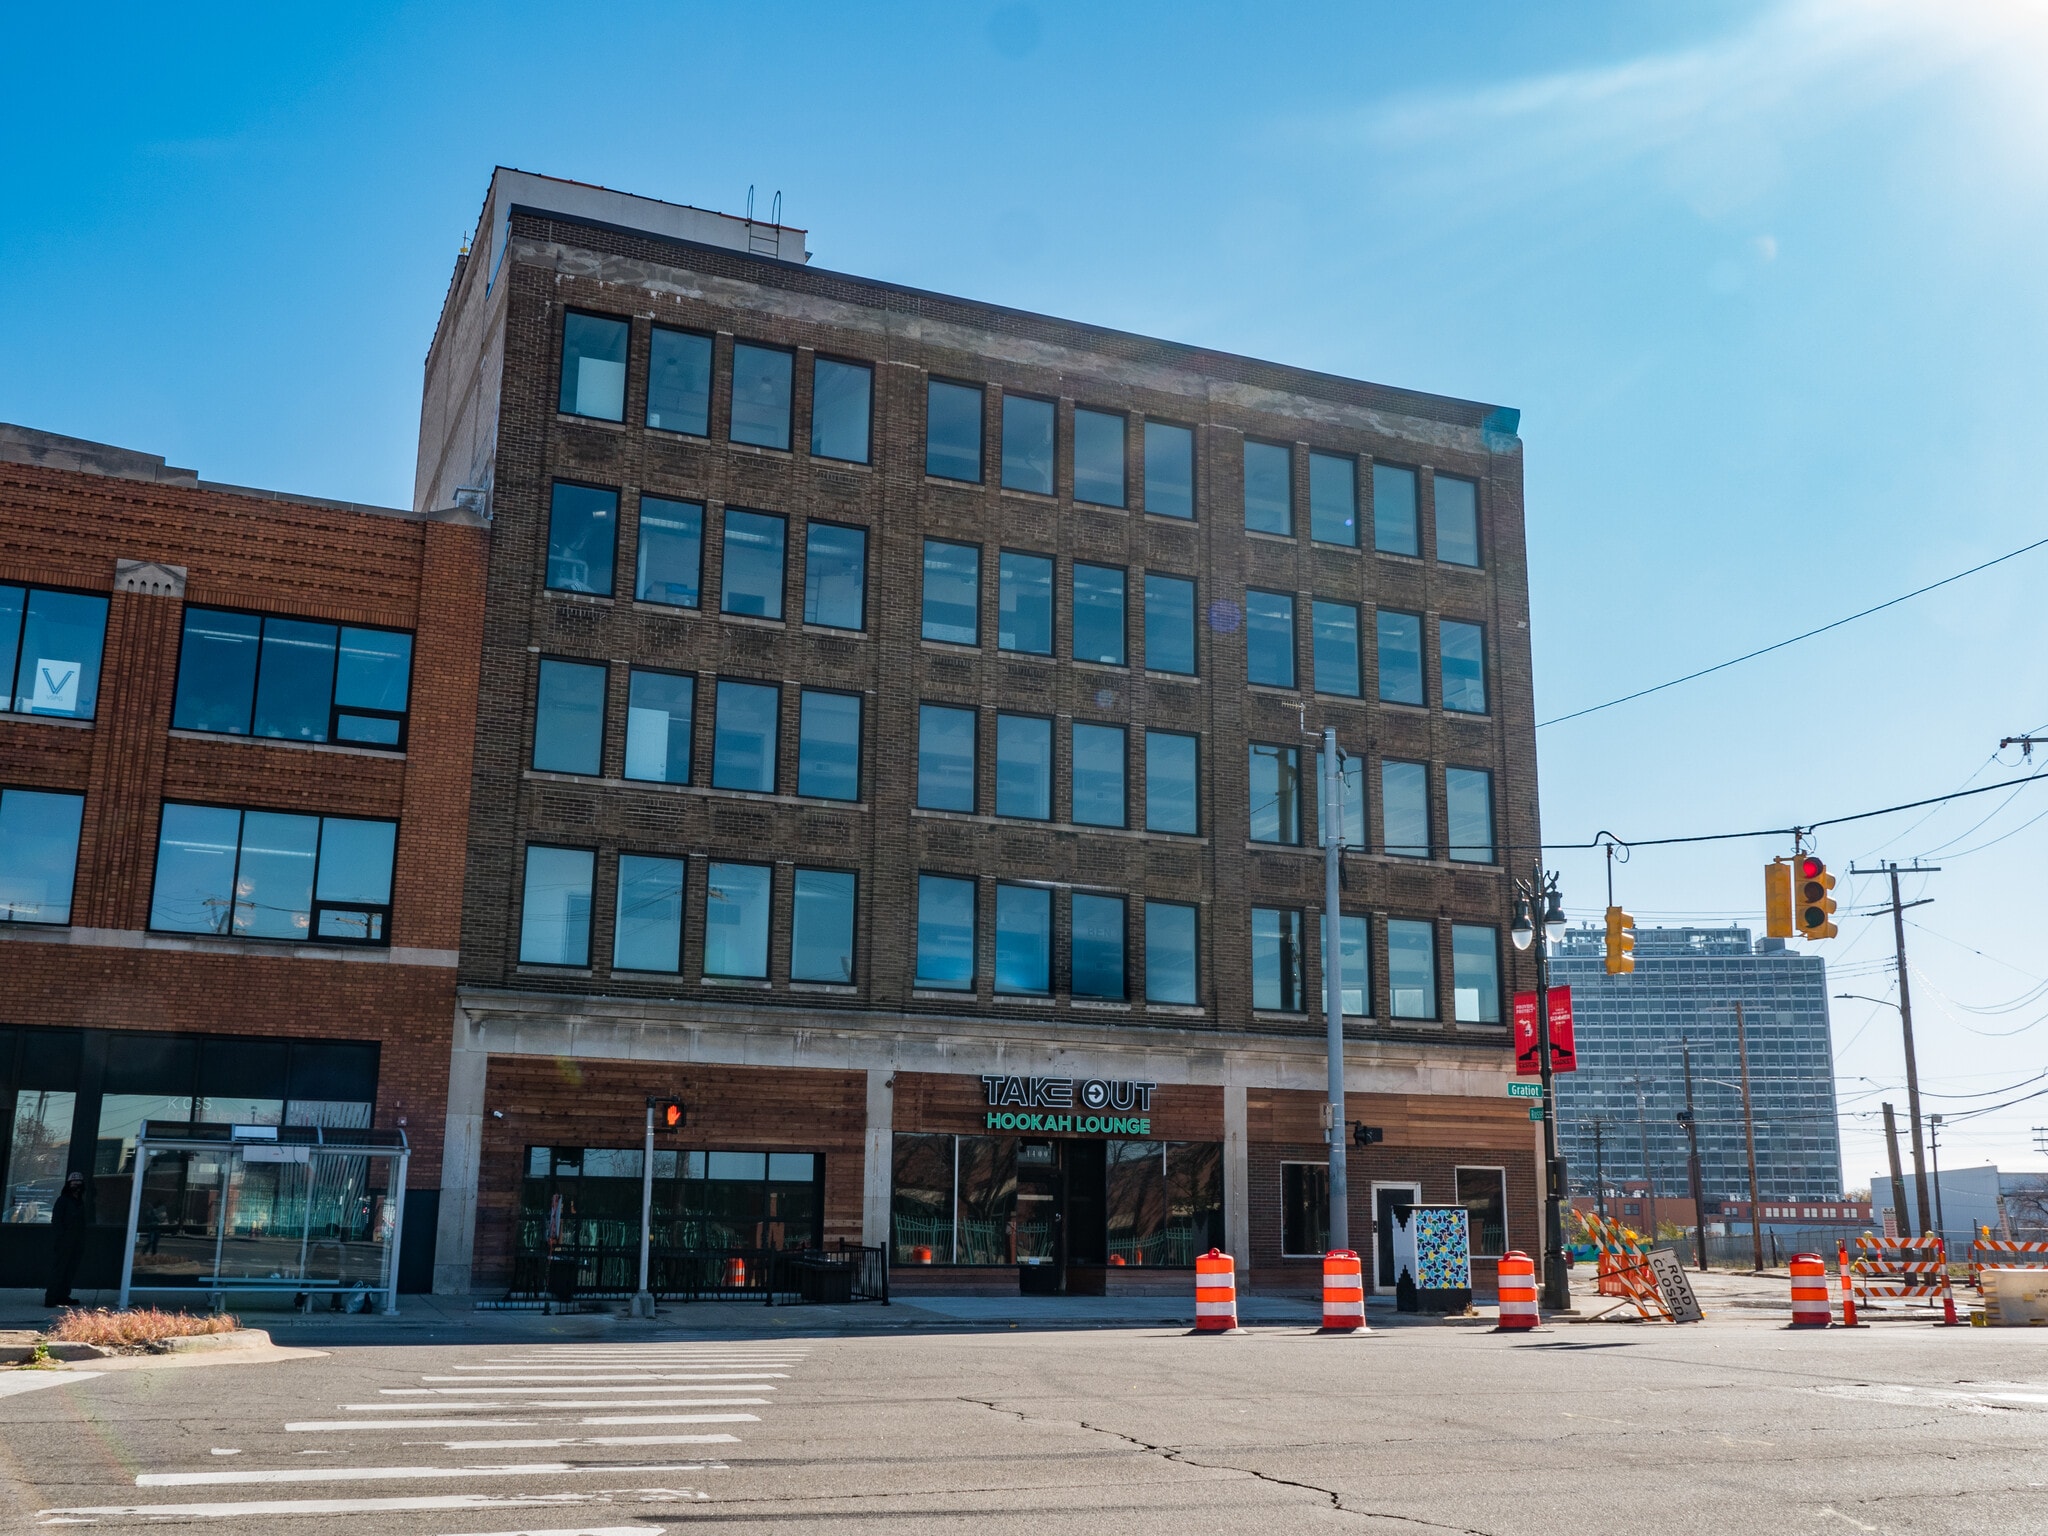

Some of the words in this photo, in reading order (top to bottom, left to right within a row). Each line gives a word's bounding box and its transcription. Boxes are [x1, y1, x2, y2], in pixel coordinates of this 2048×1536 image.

[982, 1074, 1073, 1108] TAKE
[1082, 1078, 1157, 1111] OUT
[1511, 1084, 1539, 1097] Gratiot
[986, 1112, 1072, 1131] HOOKAH
[1076, 1116, 1151, 1135] LOUNGE
[1653, 1258, 1684, 1316] CLOSED
[1668, 1265, 1692, 1306] ROAD
